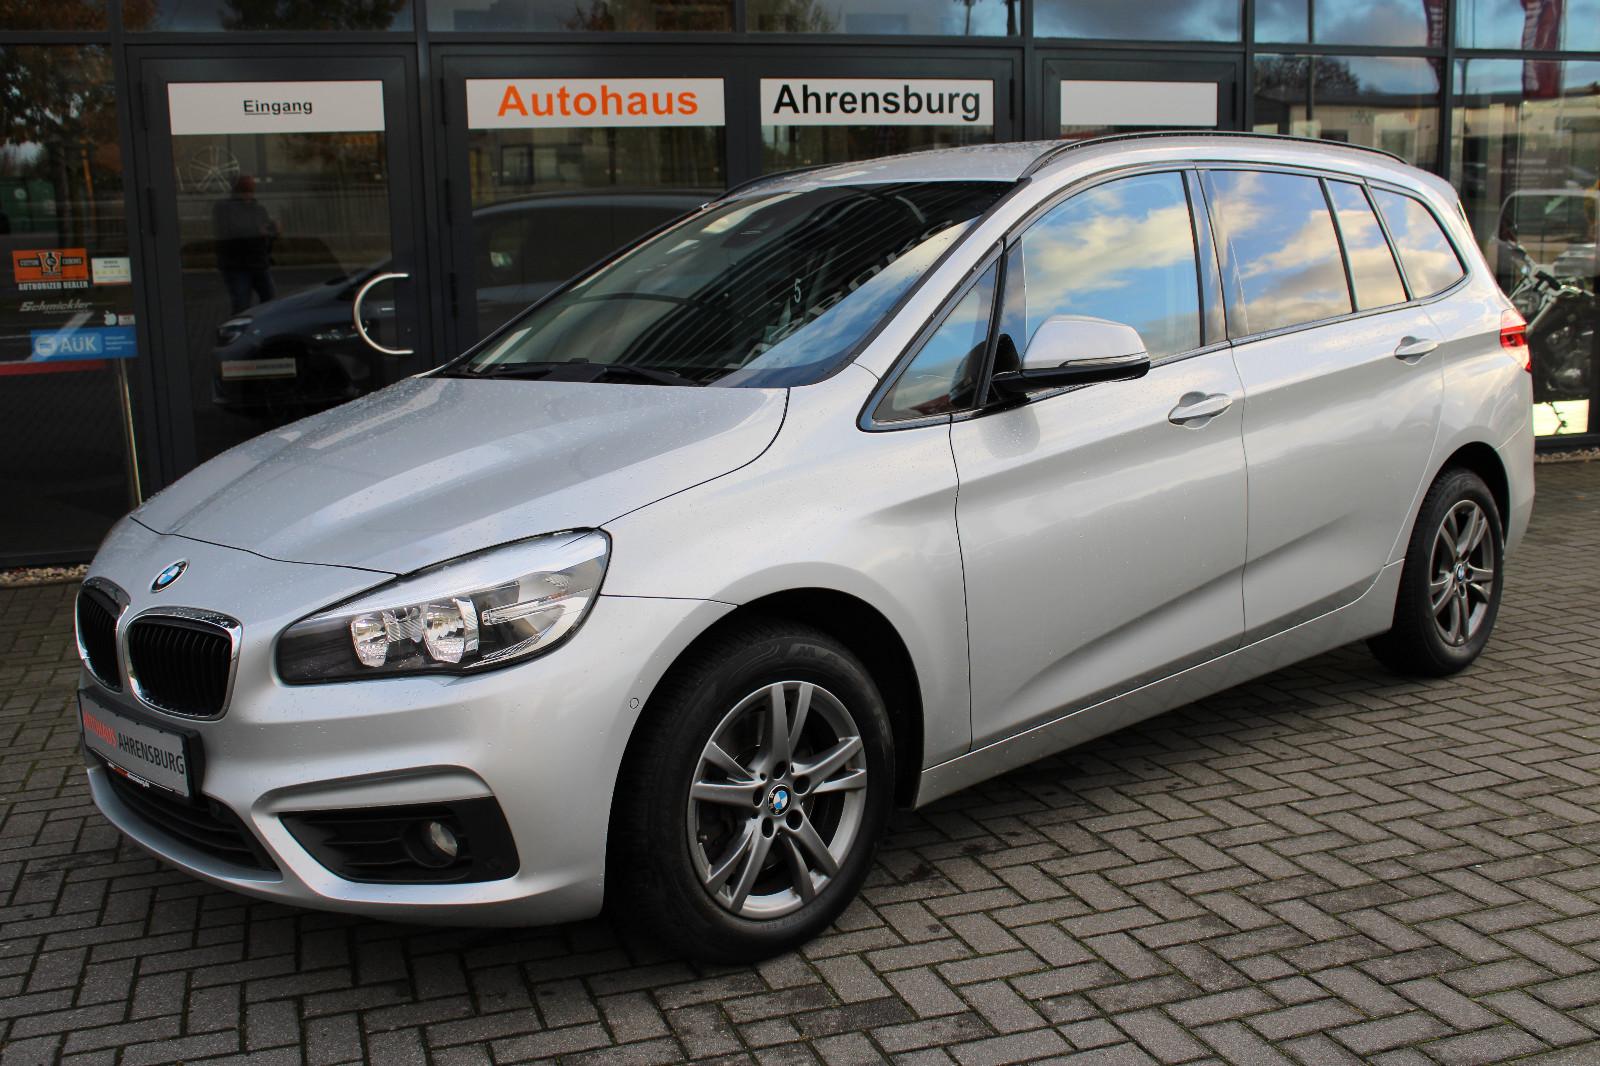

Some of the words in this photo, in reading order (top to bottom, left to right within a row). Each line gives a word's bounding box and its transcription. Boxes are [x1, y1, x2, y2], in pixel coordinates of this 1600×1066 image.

[243, 99, 313, 115] Eingang
[498, 84, 698, 116] Autohaus
[773, 84, 981, 121] Ahrensburg
[18, 282, 62, 291] AUTHORIZED
[118, 733, 184, 774] AHRENSBURG
